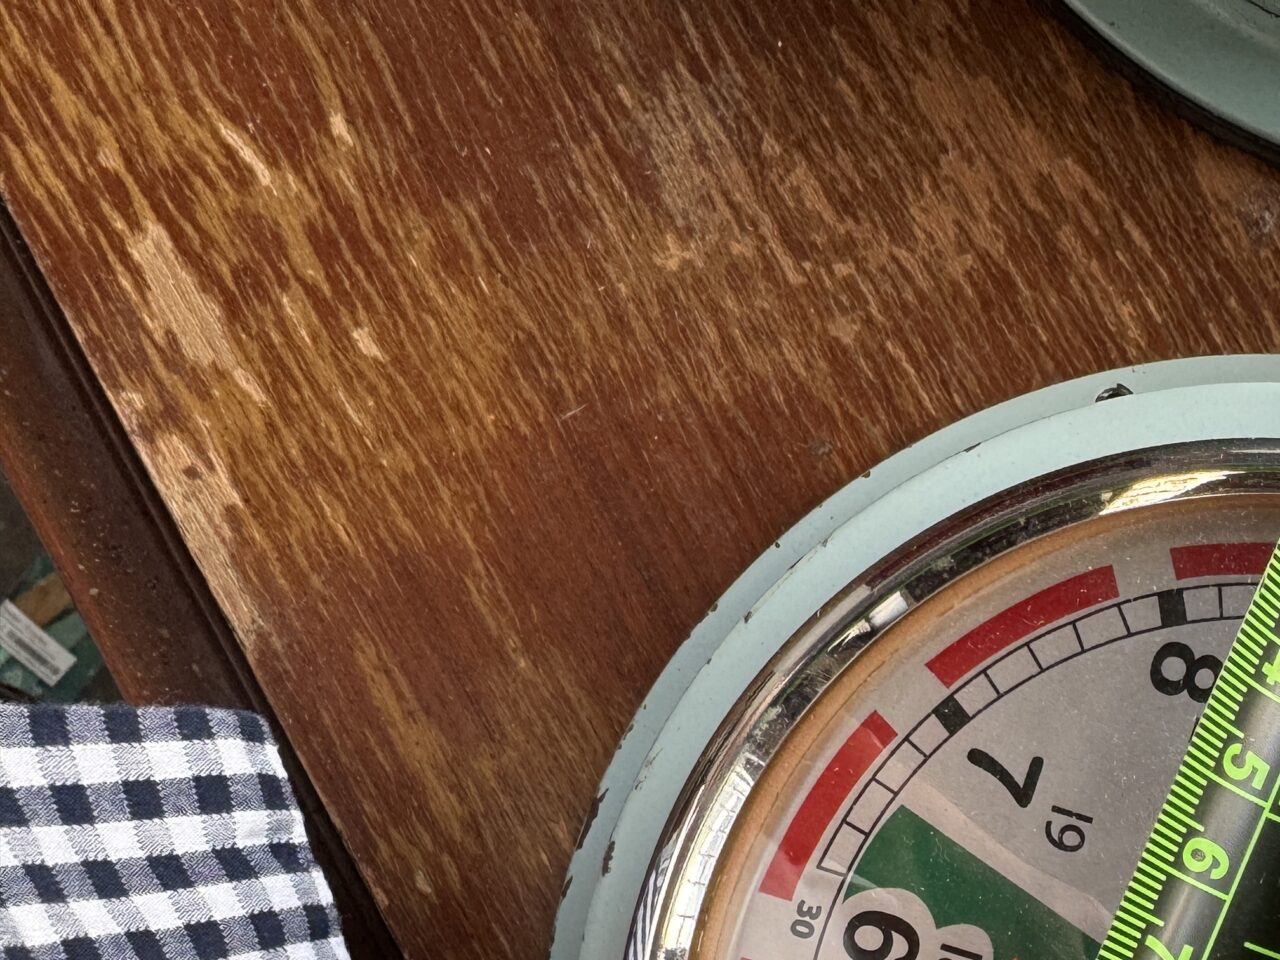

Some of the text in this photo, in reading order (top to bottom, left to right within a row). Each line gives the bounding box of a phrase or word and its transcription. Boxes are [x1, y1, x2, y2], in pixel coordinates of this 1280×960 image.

[1150, 642, 1223, 703] 8
[966, 747, 1044, 808] 7
[1223, 743, 1270, 790] 5
[1045, 805, 1093, 852] 19
[1182, 837, 1229, 880] 6
[790, 899, 822, 940] 30
